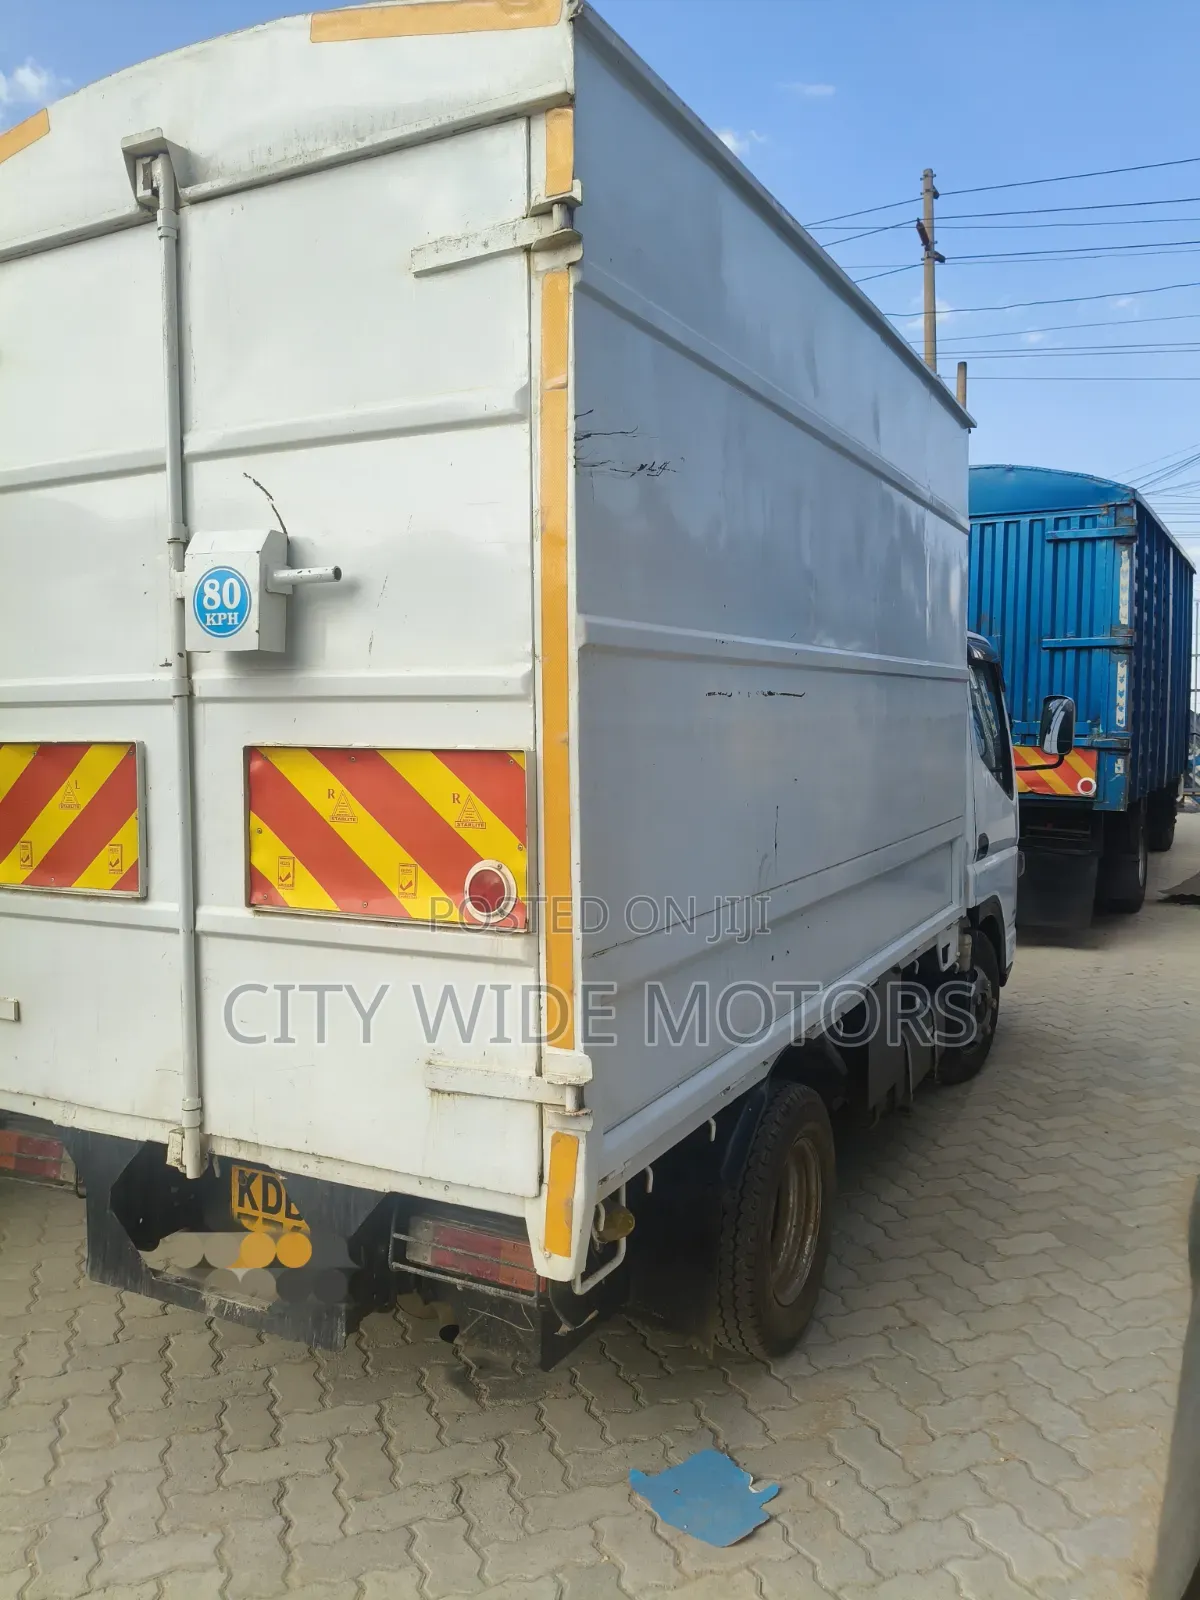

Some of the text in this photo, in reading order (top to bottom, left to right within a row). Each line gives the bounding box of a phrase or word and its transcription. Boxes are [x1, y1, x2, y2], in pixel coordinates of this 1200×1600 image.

[202, 577, 242, 611] 80
[205, 612, 239, 626] KPH
[327, 788, 335, 799] R
[452, 792, 461, 804] R
